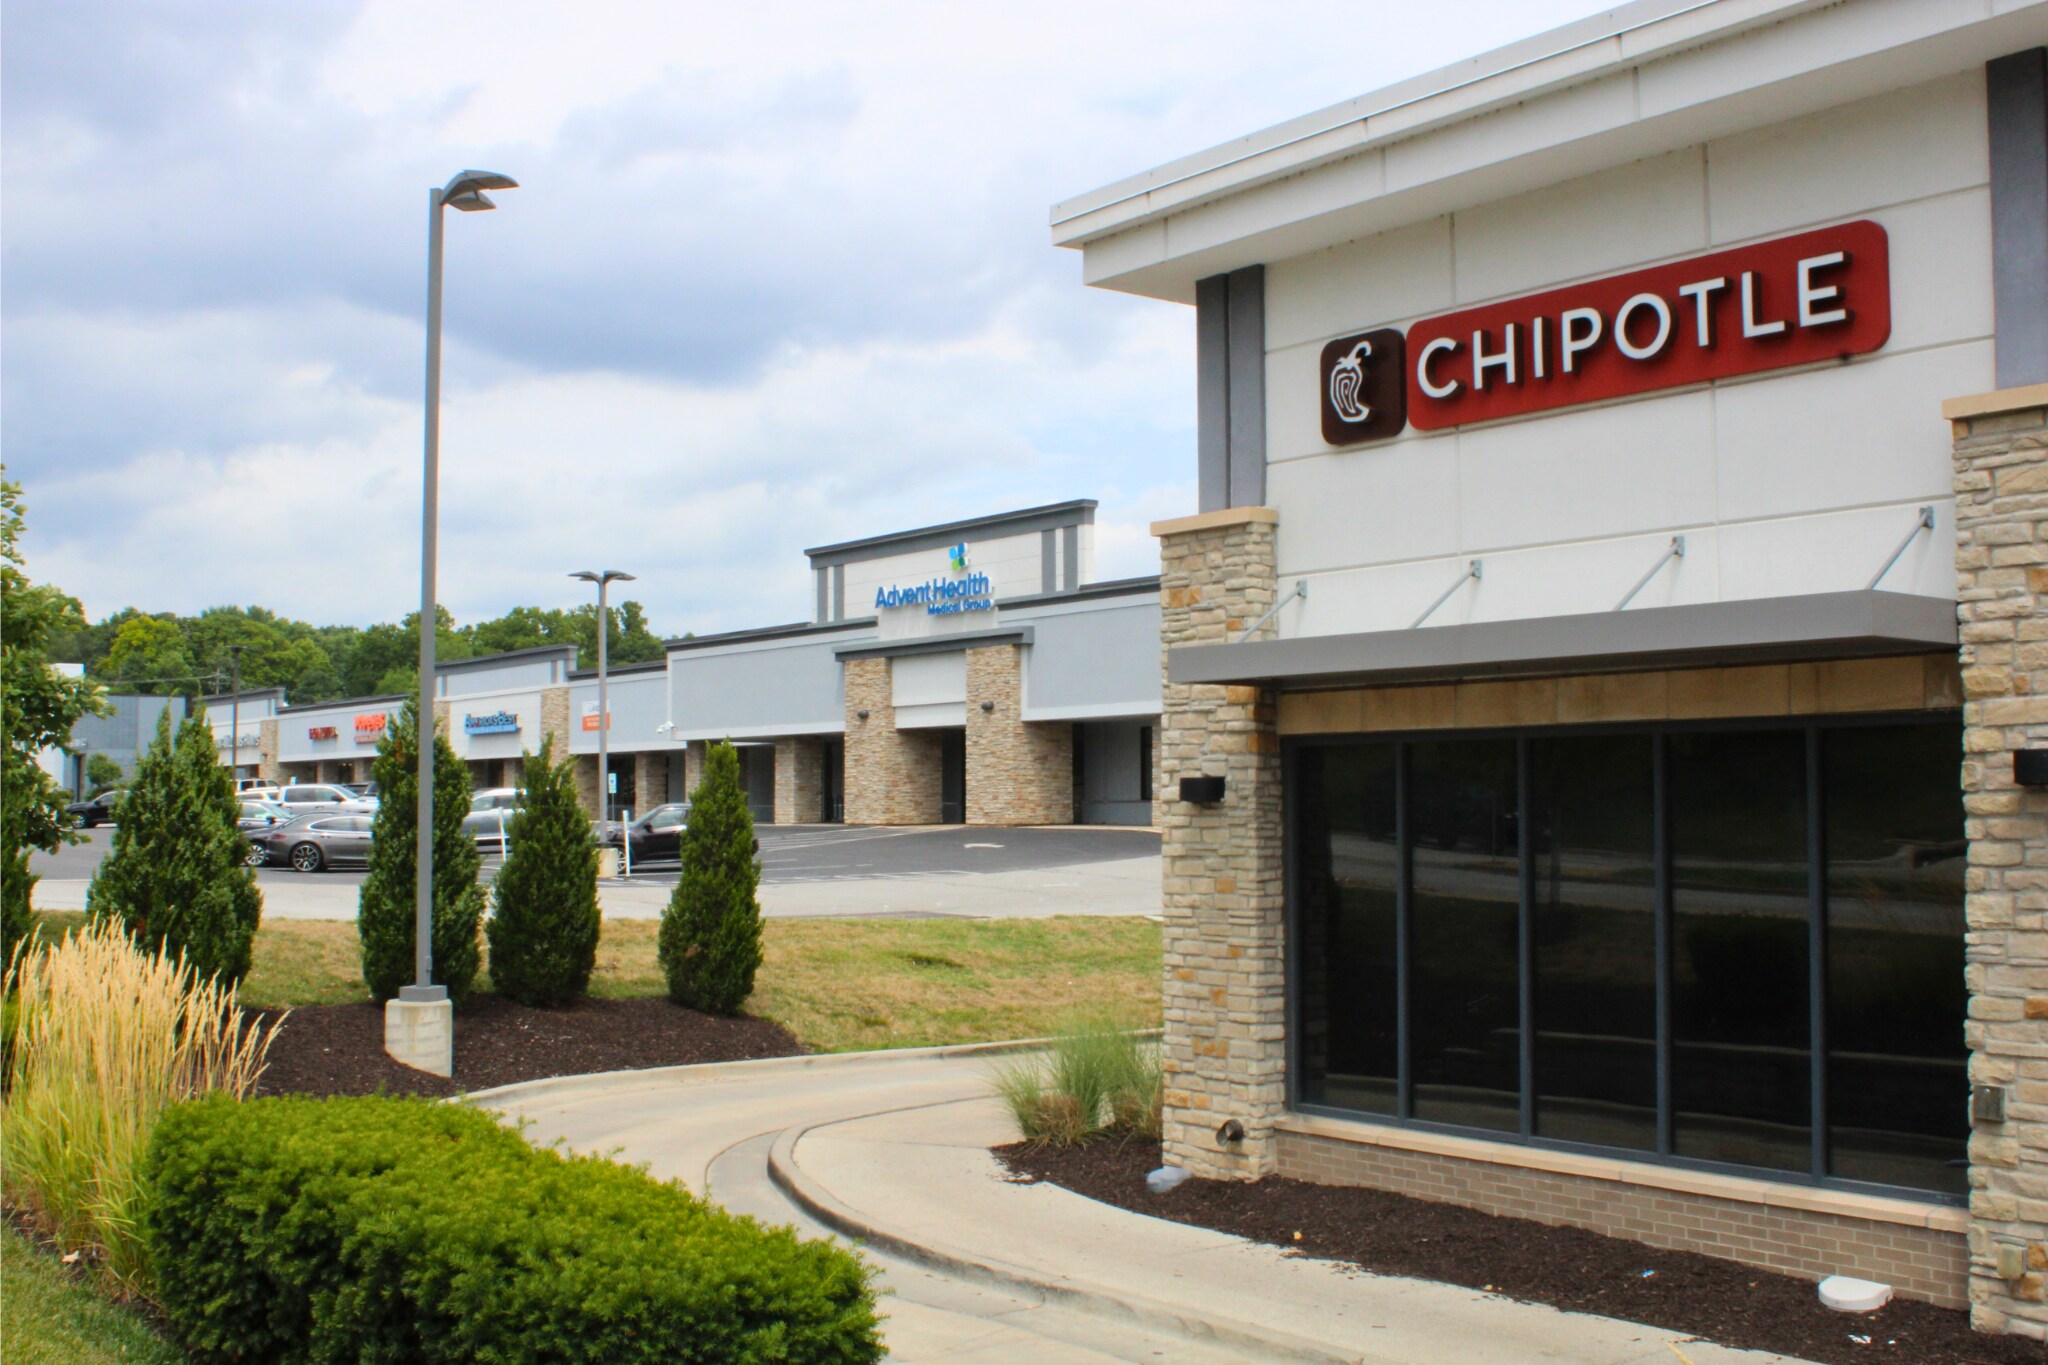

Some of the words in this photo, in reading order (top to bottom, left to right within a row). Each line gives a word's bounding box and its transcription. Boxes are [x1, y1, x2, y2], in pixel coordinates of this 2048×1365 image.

[1416, 250, 1850, 399] CHIPOTLE
[928, 602, 960, 615] Medical
[963, 599, 990, 611] Group
